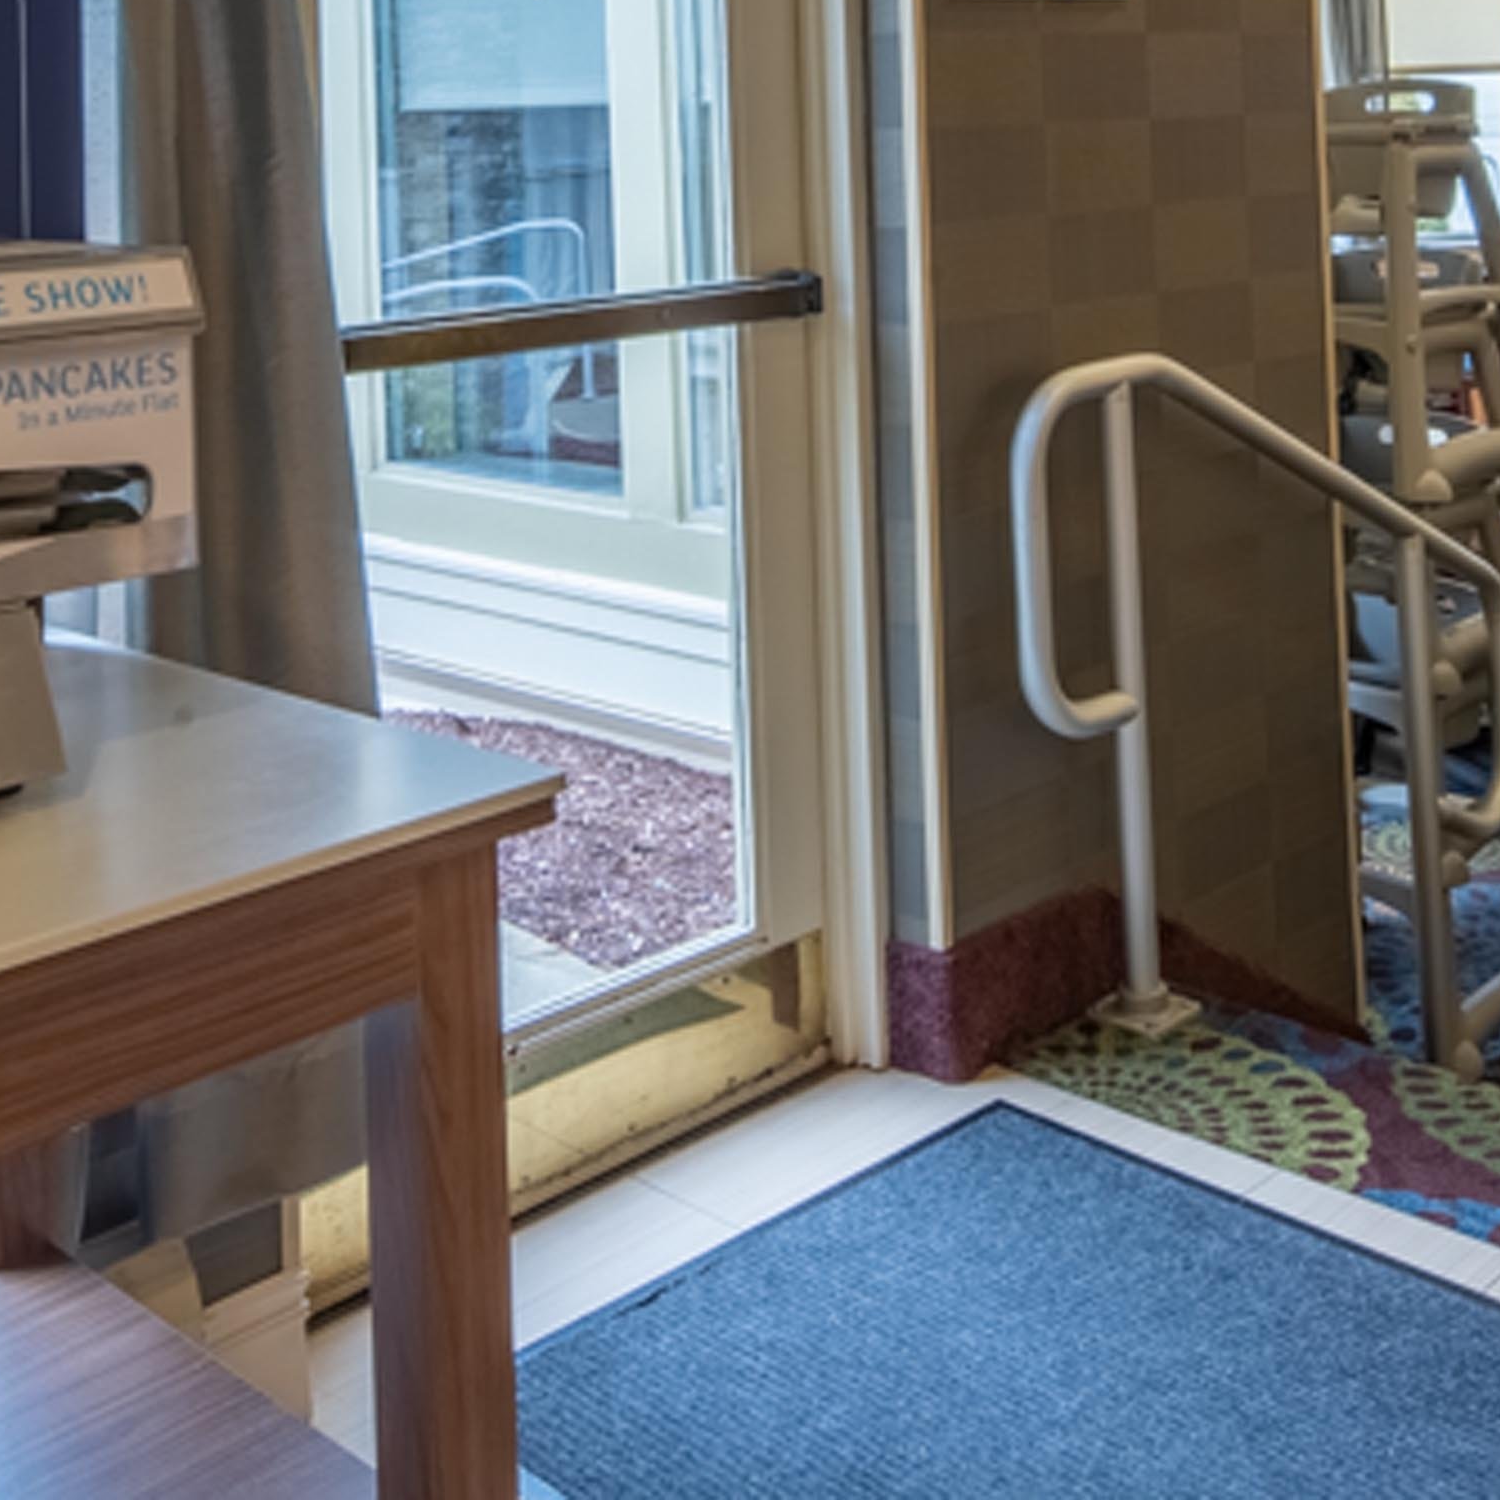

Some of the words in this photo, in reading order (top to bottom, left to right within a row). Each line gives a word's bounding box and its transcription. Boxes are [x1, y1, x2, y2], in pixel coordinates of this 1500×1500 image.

[24, 274, 148, 313] SHOW!
[65, 399, 137, 422] Minute
[142, 391, 180, 412] Flat
